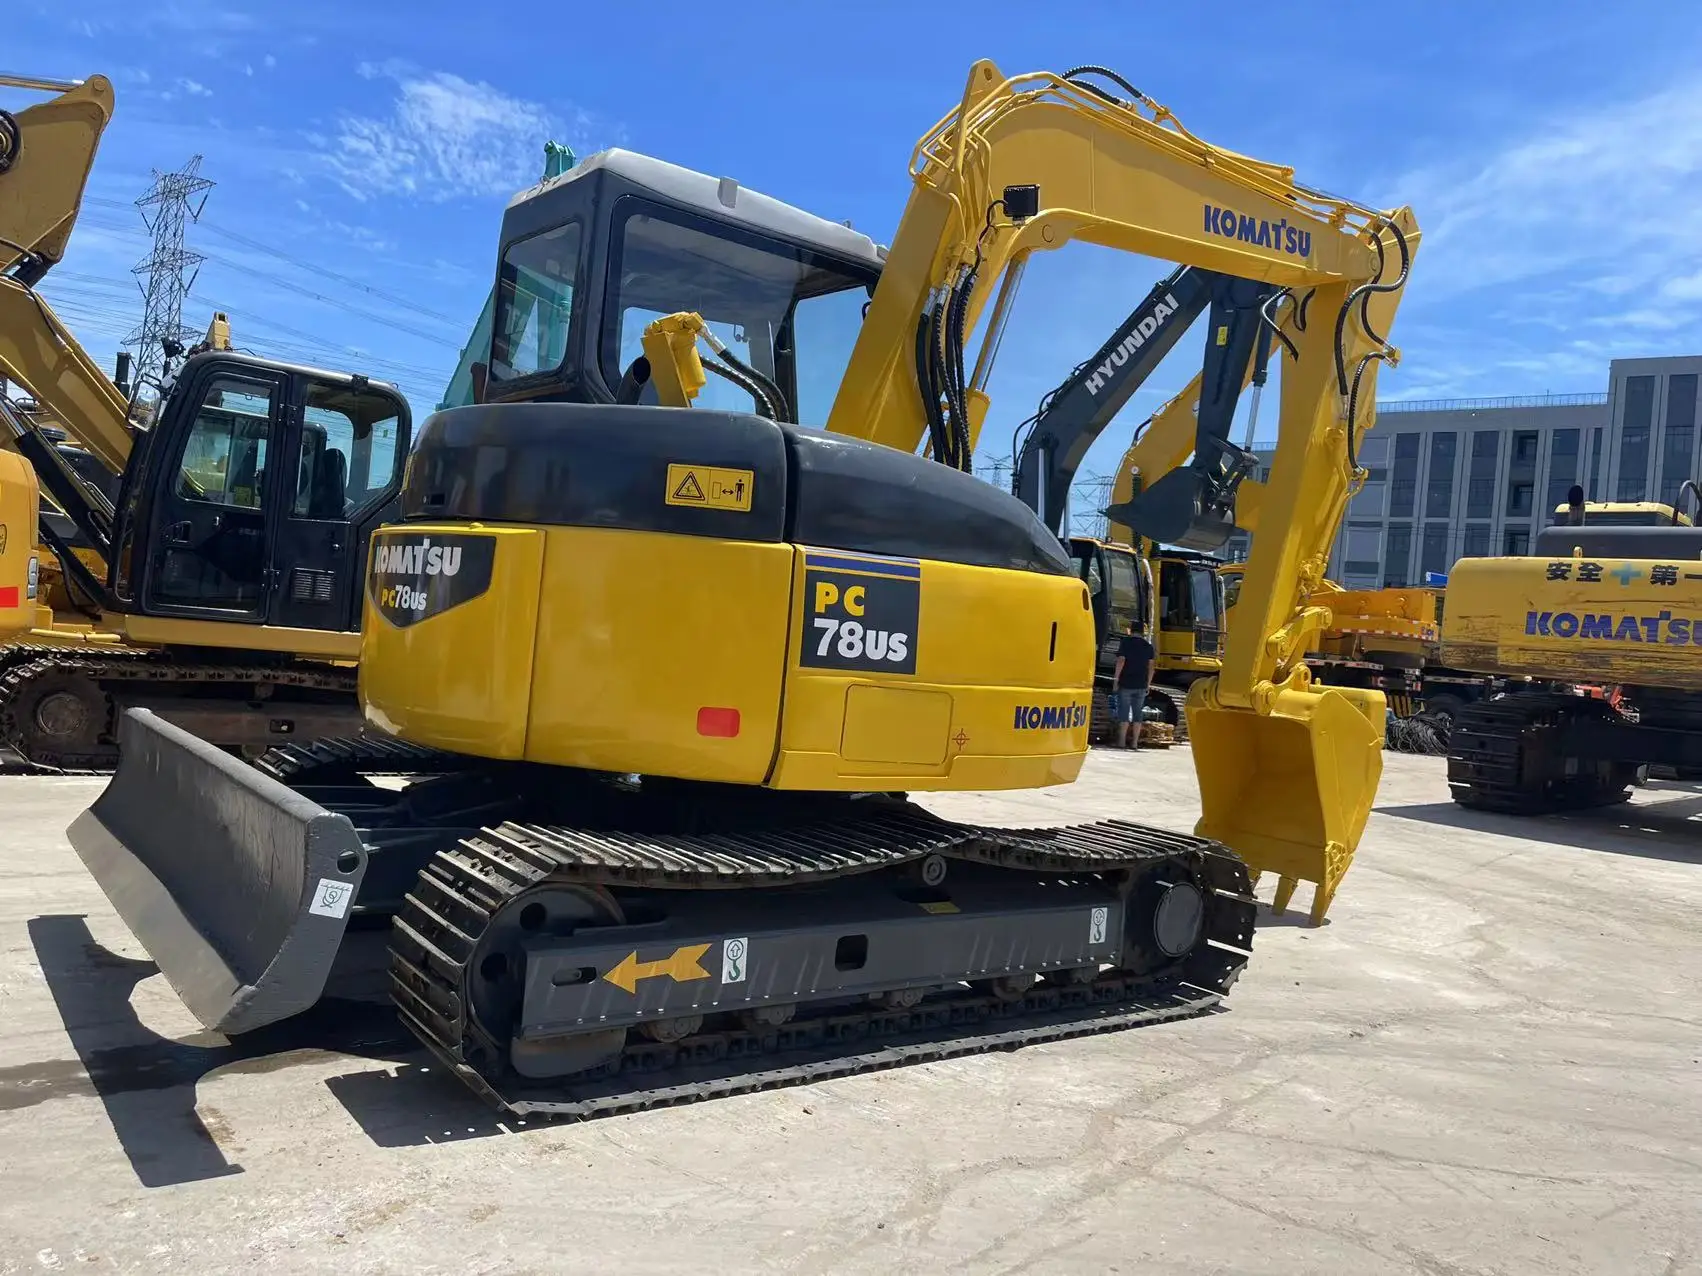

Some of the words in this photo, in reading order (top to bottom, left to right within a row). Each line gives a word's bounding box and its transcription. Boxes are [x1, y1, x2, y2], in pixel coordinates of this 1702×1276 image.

[1204, 204, 1311, 257] KOMATSU
[1084, 293, 1179, 396] HYUNDAI
[375, 538, 462, 576] KOMATSU
[1546, 562, 1604, 583] 安全
[815, 581, 866, 617] PC
[813, 617, 909, 662] 78US
[1013, 701, 1087, 730] KOMATSU
